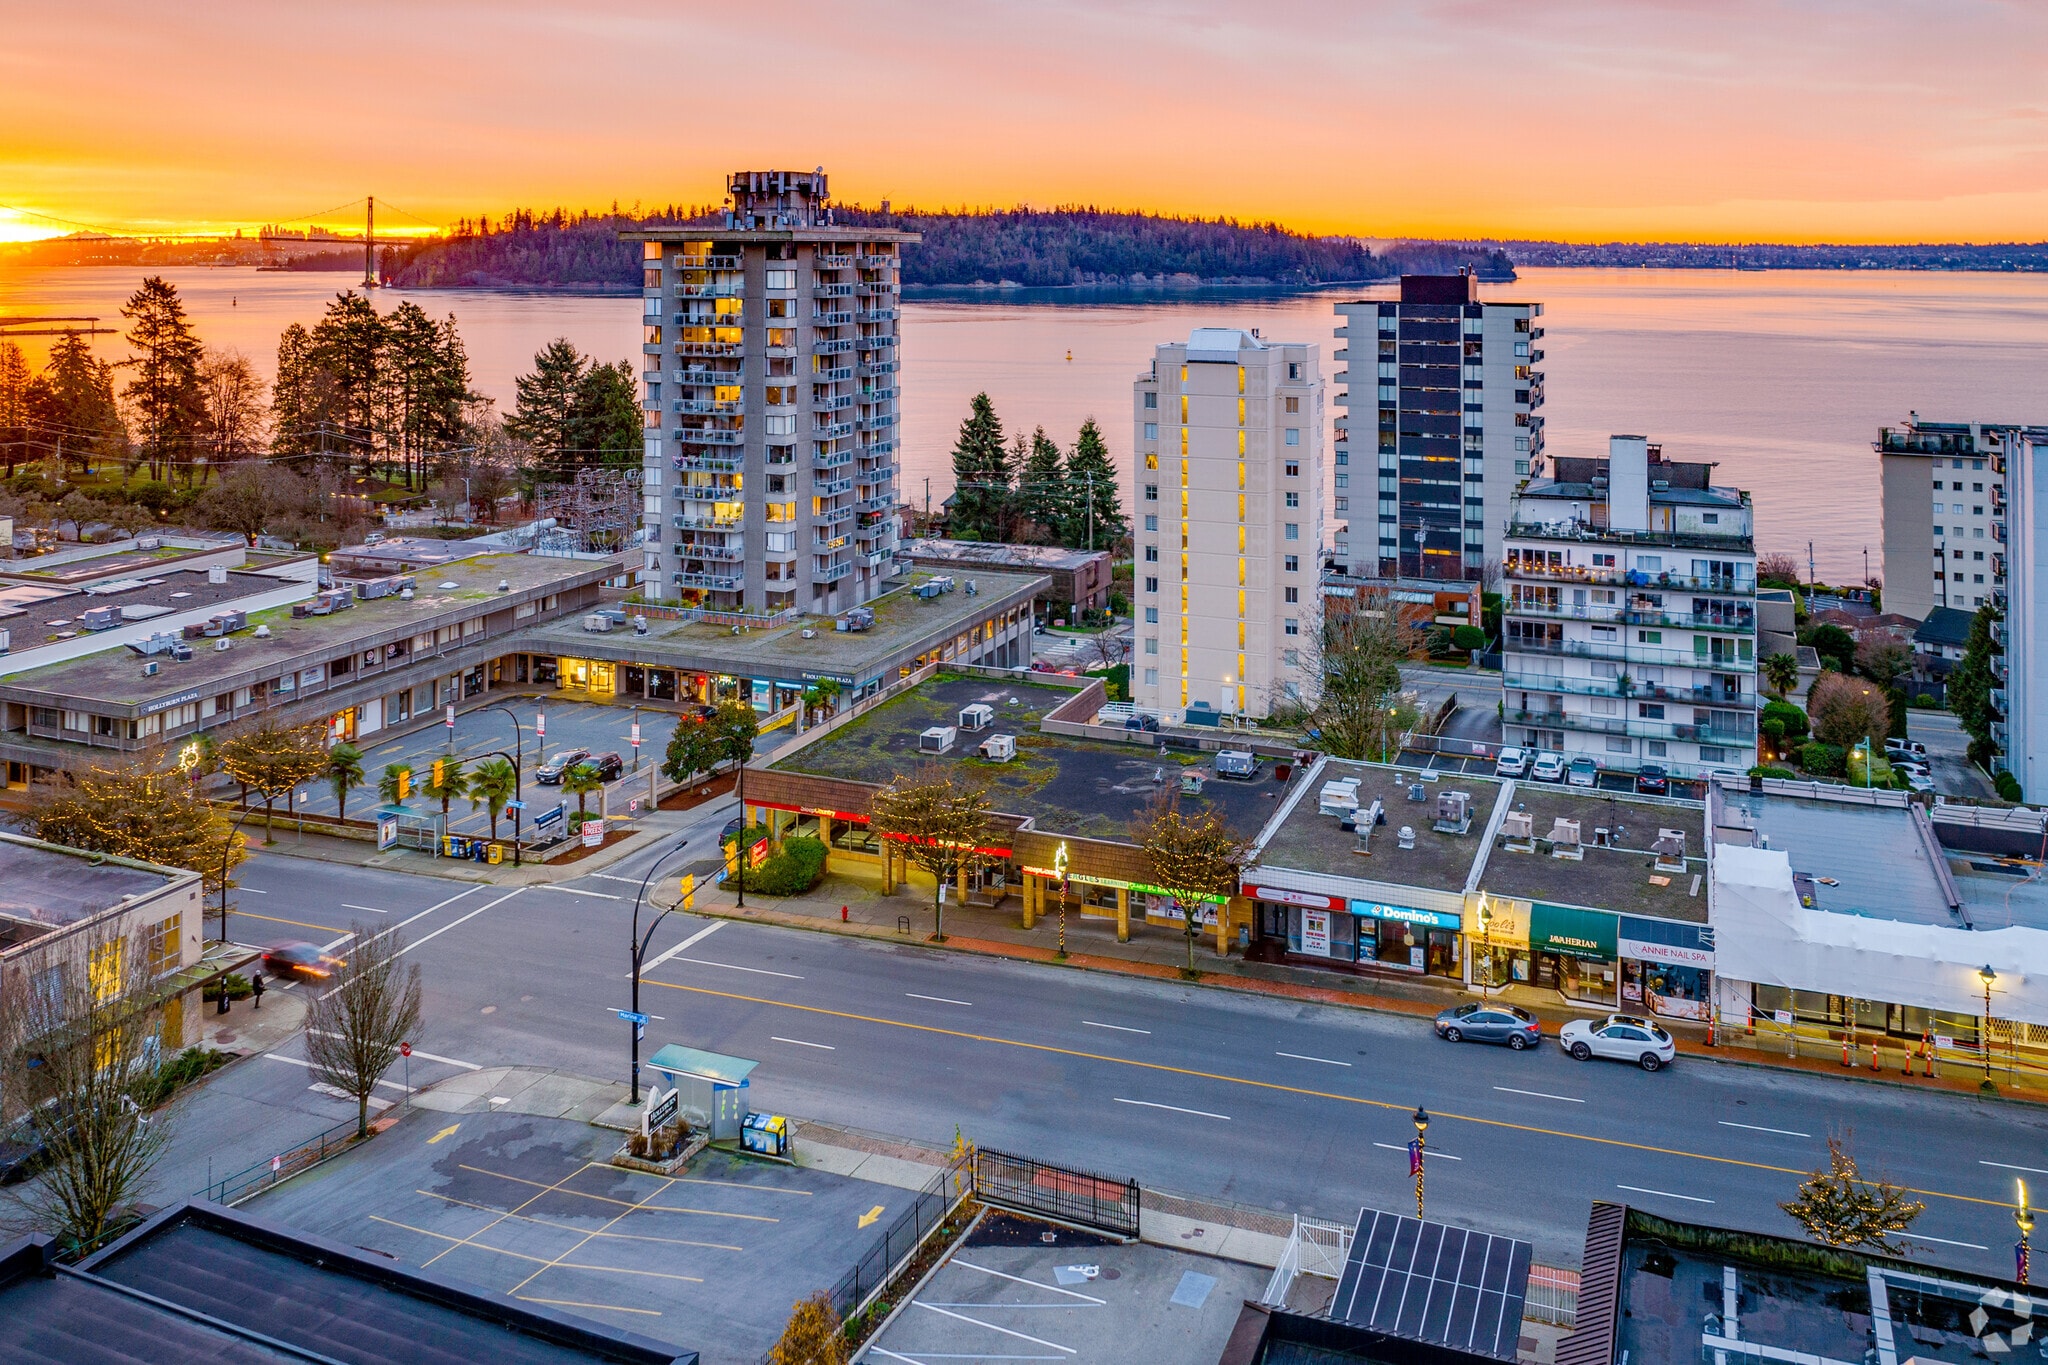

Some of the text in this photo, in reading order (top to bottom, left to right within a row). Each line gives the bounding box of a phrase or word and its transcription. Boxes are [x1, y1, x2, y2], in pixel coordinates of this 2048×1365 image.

[147, 692, 198, 712] HOLLYBURN PLAZA
[1068, 873, 1100, 883] EAGLES
[1100, 879, 1128, 888] LEARNING
[1383, 905, 1438, 925] Domino's
[1549, 934, 1597, 949] JAVAHERIAN
[1641, 945, 1668, 957] ANNIE
[1671, 949, 1689, 960] NAIL
[1691, 952, 1707, 962] SPA
